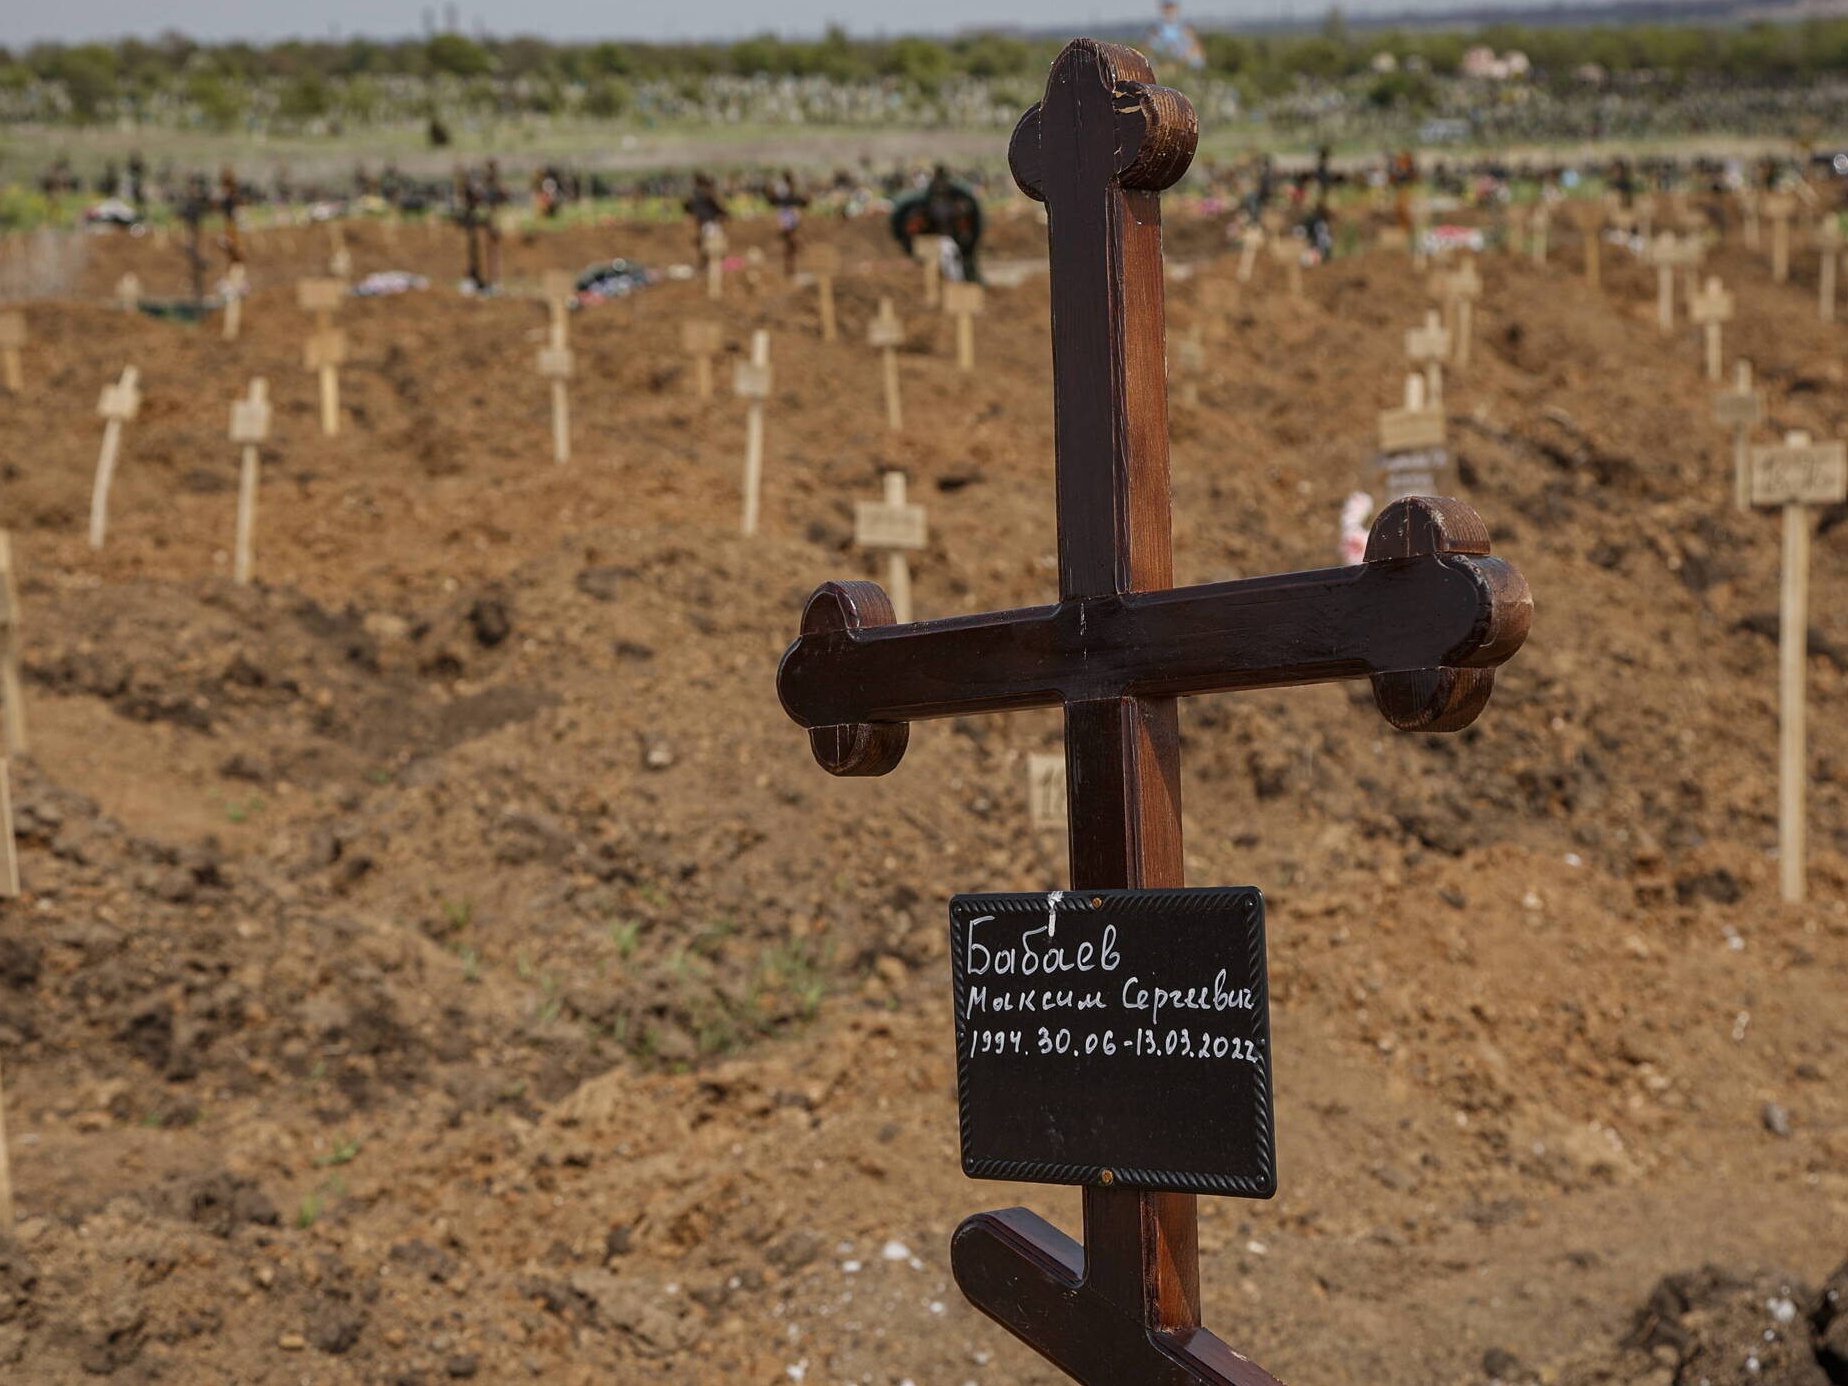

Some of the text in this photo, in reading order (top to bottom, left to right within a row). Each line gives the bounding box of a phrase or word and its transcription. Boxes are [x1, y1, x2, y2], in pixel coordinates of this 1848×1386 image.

[967, 915, 1121, 976] Бабаев
[966, 968, 1255, 1025] Максим Сергеевич
